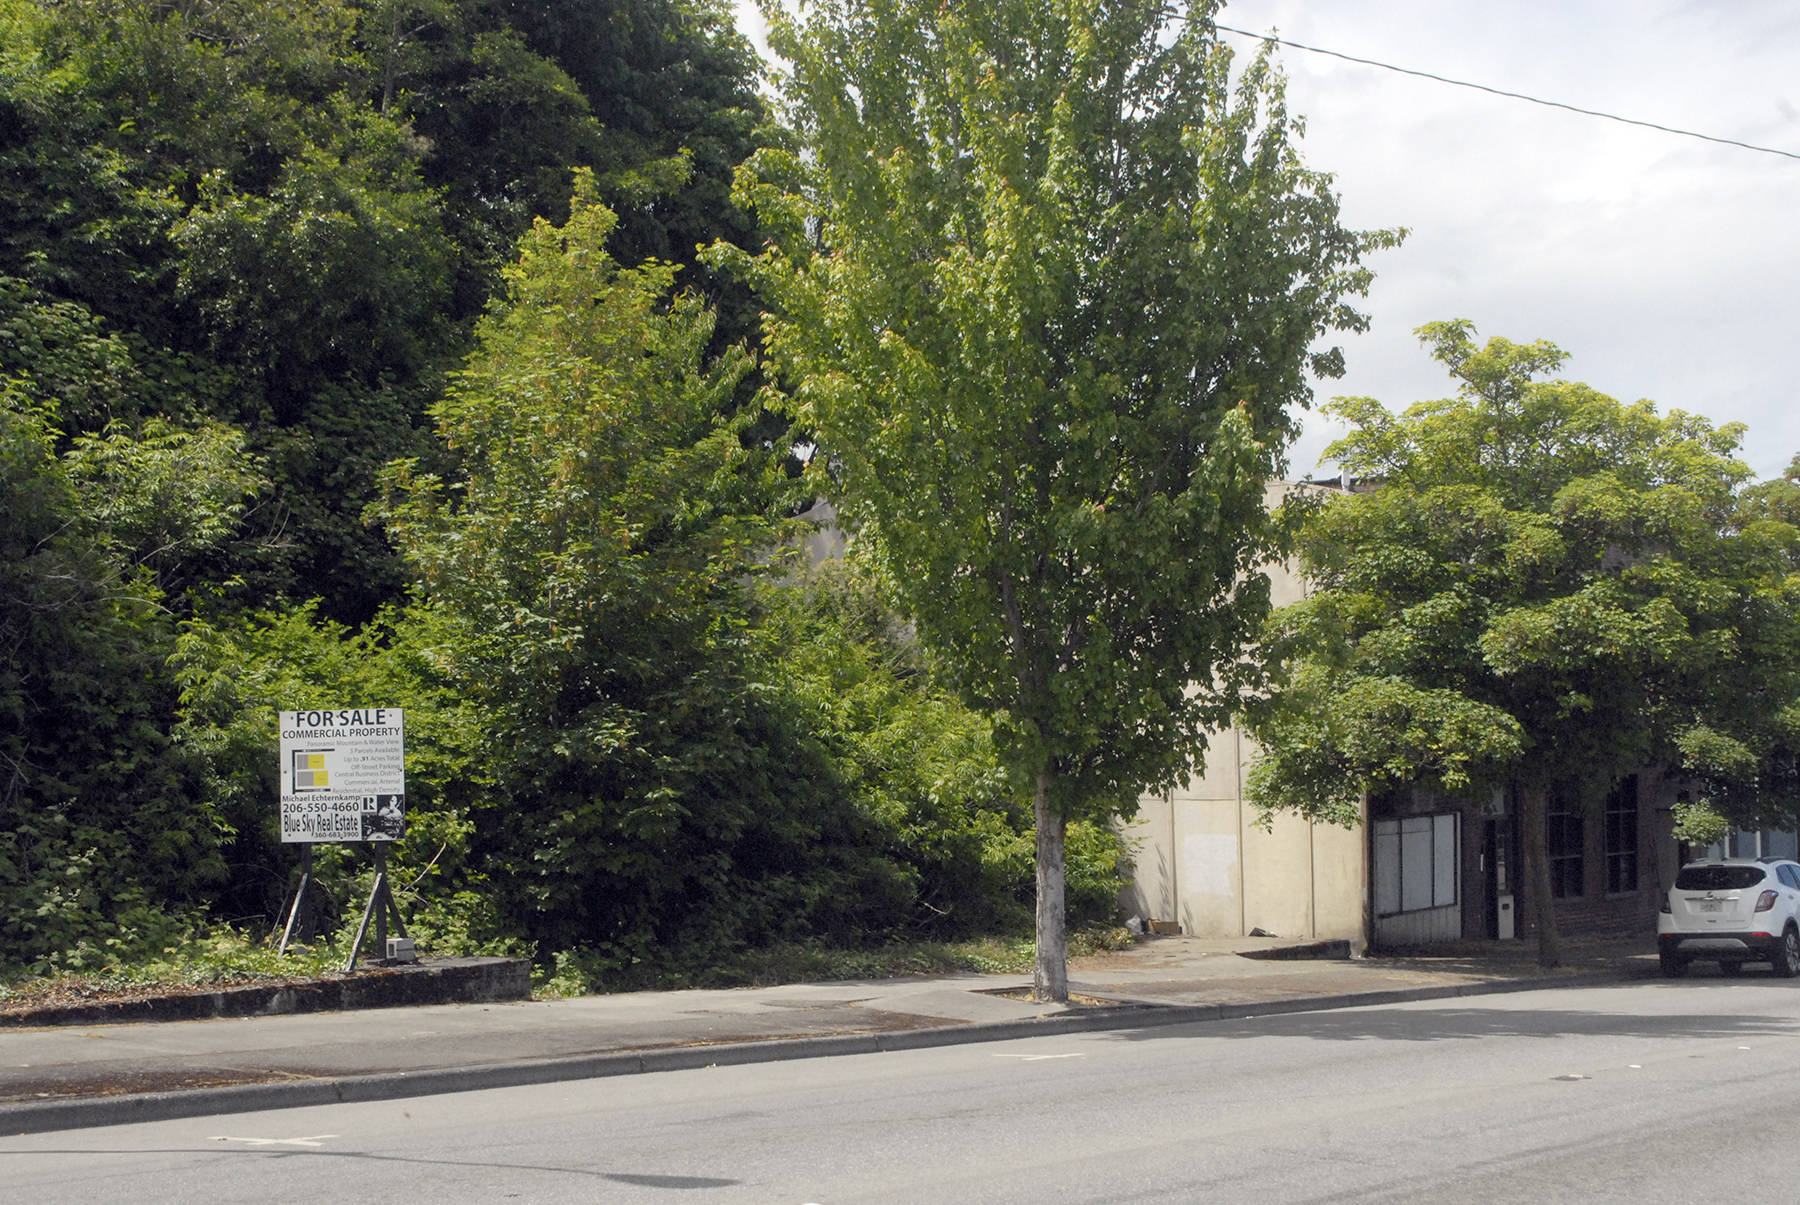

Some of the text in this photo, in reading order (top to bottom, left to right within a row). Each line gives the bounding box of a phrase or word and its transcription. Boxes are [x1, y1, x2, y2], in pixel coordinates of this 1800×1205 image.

[296, 710, 386, 728] FOR SALE
[282, 727, 400, 739] COMMERCIAL PROPERTY
[312, 794, 360, 802] Echternkamp
[282, 802, 360, 813] 206-550-4660
[284, 813, 358, 836] Blue Sky Real Estate
